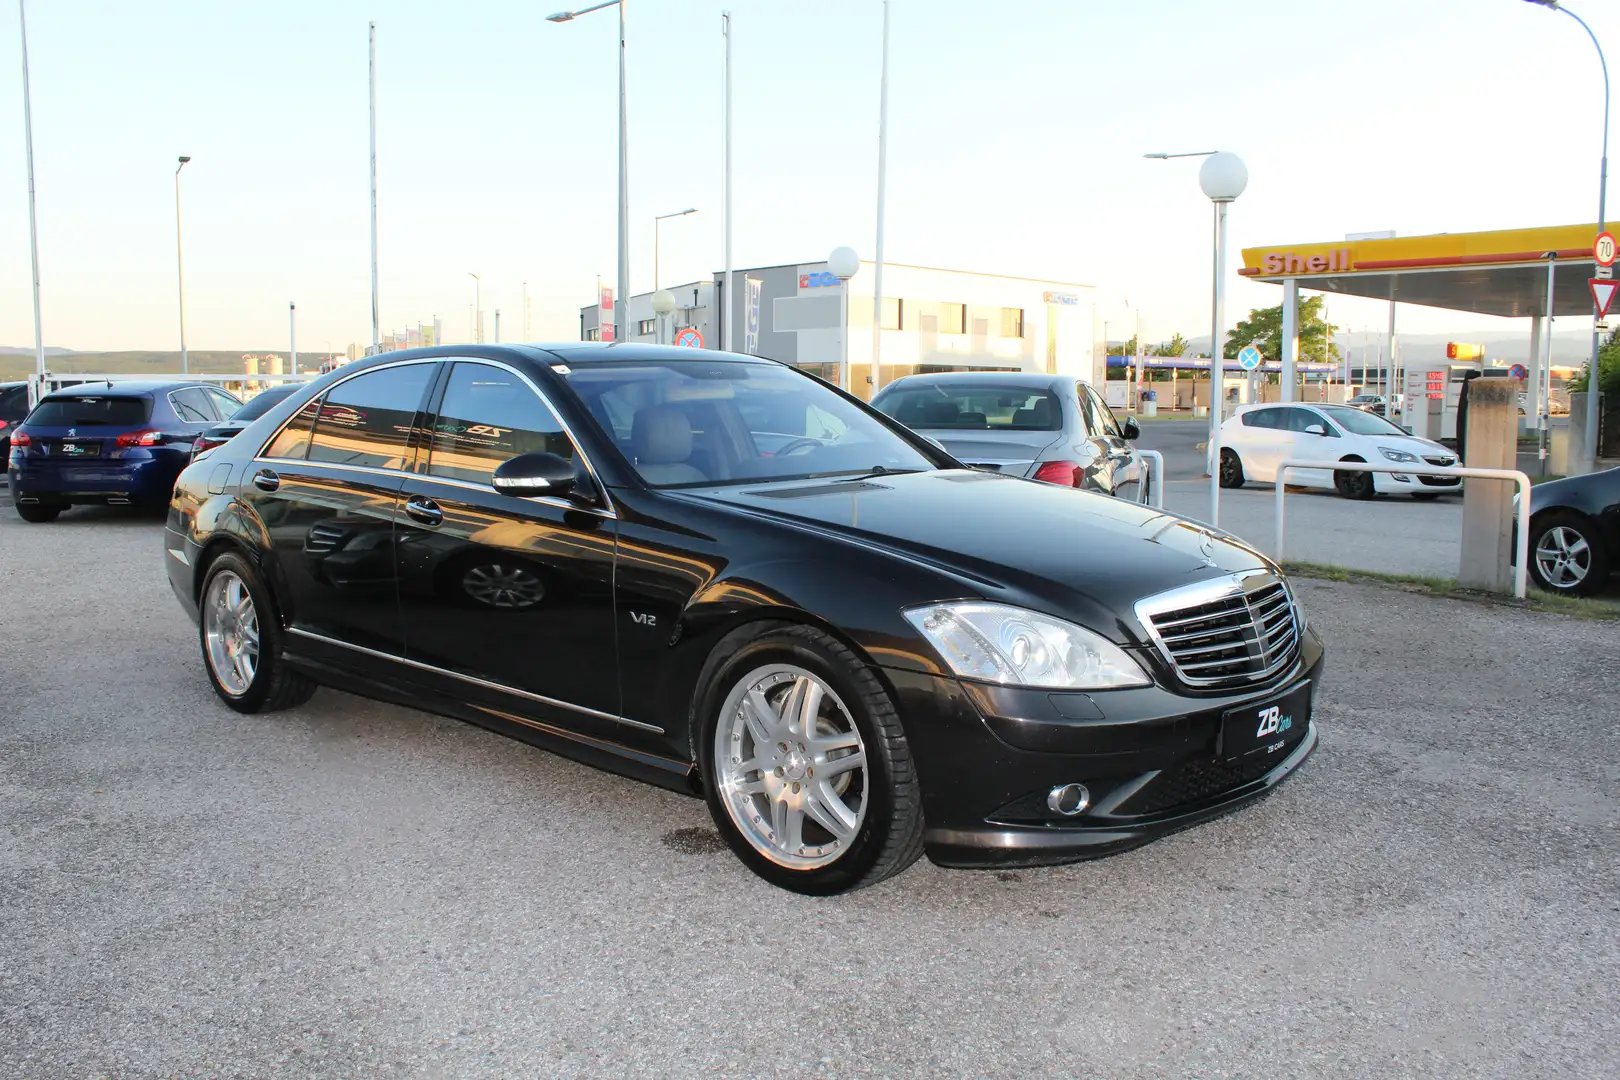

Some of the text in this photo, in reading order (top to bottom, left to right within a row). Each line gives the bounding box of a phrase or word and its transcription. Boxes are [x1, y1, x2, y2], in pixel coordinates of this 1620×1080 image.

[1600, 241, 1612, 257] 70
[1263, 248, 1349, 274] Shell
[62, 444, 75, 452] ZB
[630, 611, 656, 626] V12
[1257, 706, 1280, 738] ZB
